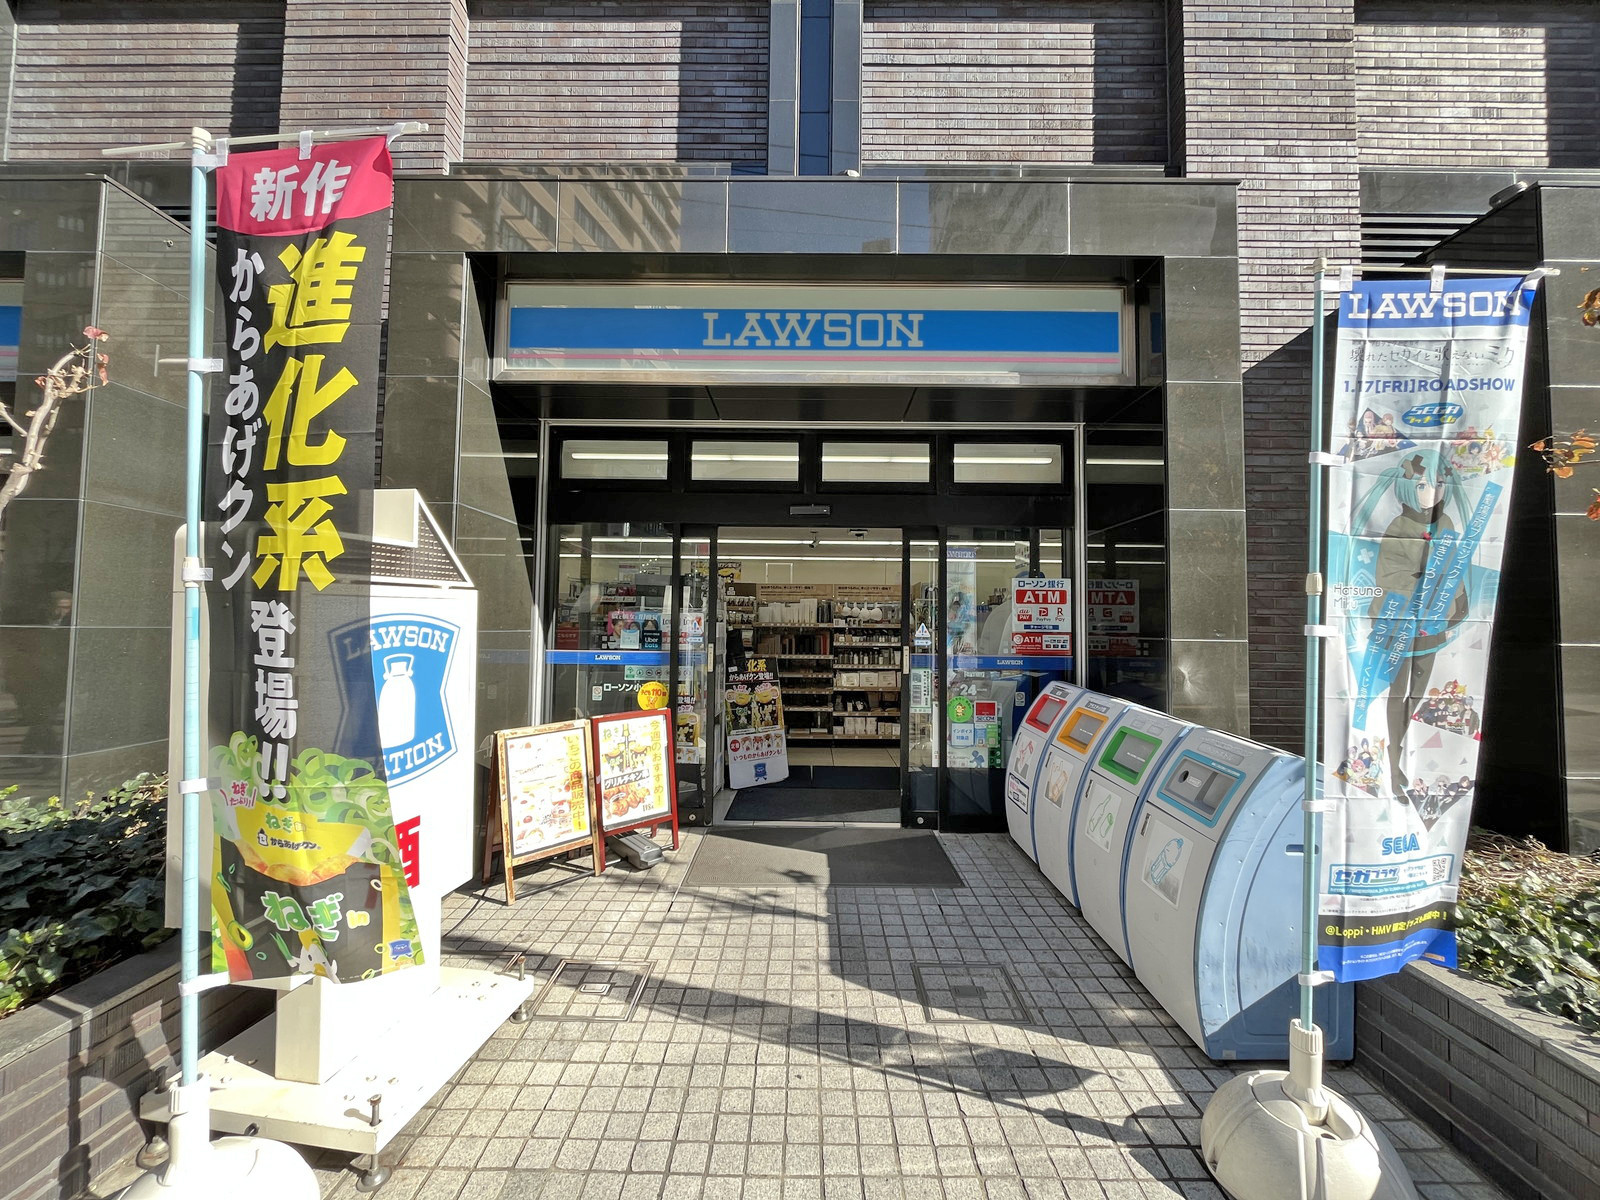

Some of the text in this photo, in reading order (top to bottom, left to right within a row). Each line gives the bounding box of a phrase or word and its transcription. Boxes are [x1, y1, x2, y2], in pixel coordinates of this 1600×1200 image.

[249, 159, 353, 222] 新作
[1347, 291, 1522, 319] LAWSON
[702, 312, 924, 349] LAWSON
[217, 247, 265, 591] からあげクン
[251, 231, 367, 592] 進化系
[1018, 580, 1064, 589] ローソン銀行
[1023, 591, 1060, 603] ATM
[1333, 583, 1383, 597] Hatsune
[343, 625, 449, 661] LAWSON
[747, 658, 767, 672] 化系
[249, 599, 299, 801] 登場!!
[960, 683, 977, 696] 24
[231, 781, 248, 796] ねぎ
[265, 812, 294, 834] ねぎ
[259, 889, 347, 944] ねぎ
